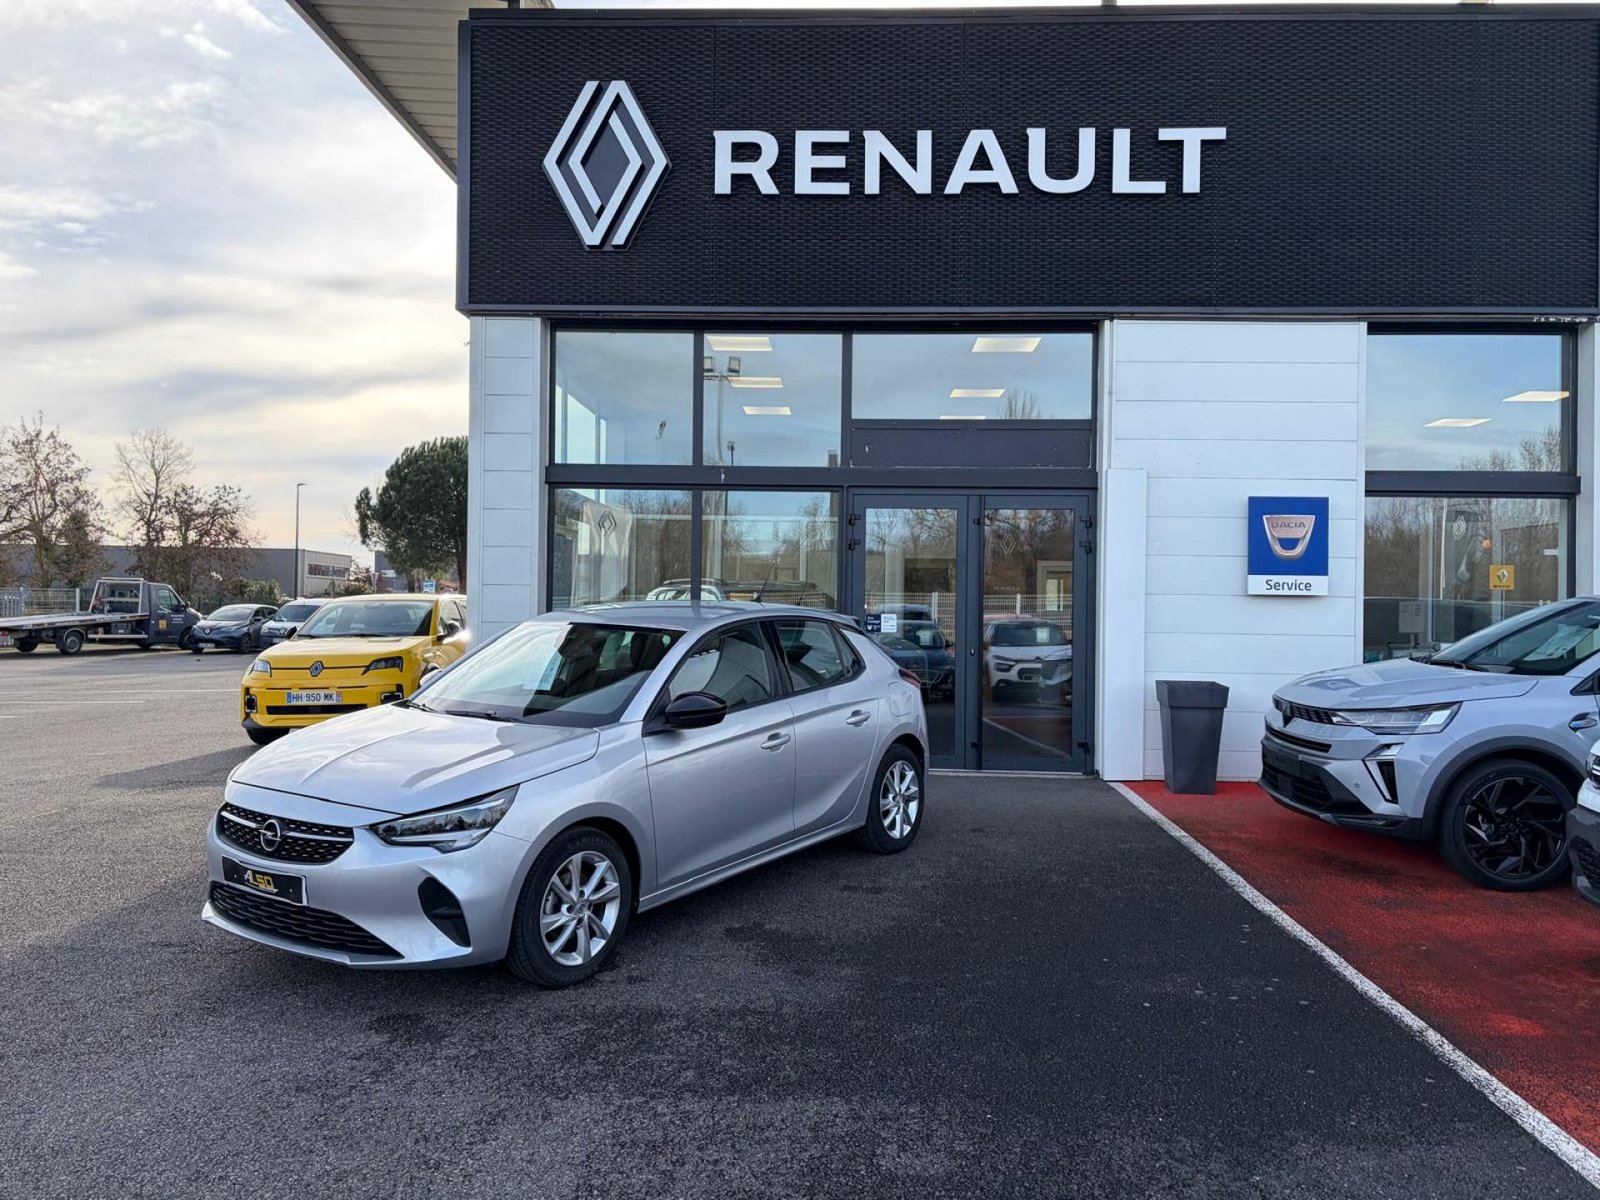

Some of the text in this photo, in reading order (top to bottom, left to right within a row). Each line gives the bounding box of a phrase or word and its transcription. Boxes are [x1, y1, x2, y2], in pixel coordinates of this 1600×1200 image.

[713, 127, 1227, 195] RENAULT
[1271, 521, 1307, 529] DACIA
[1265, 579, 1312, 591] Service
